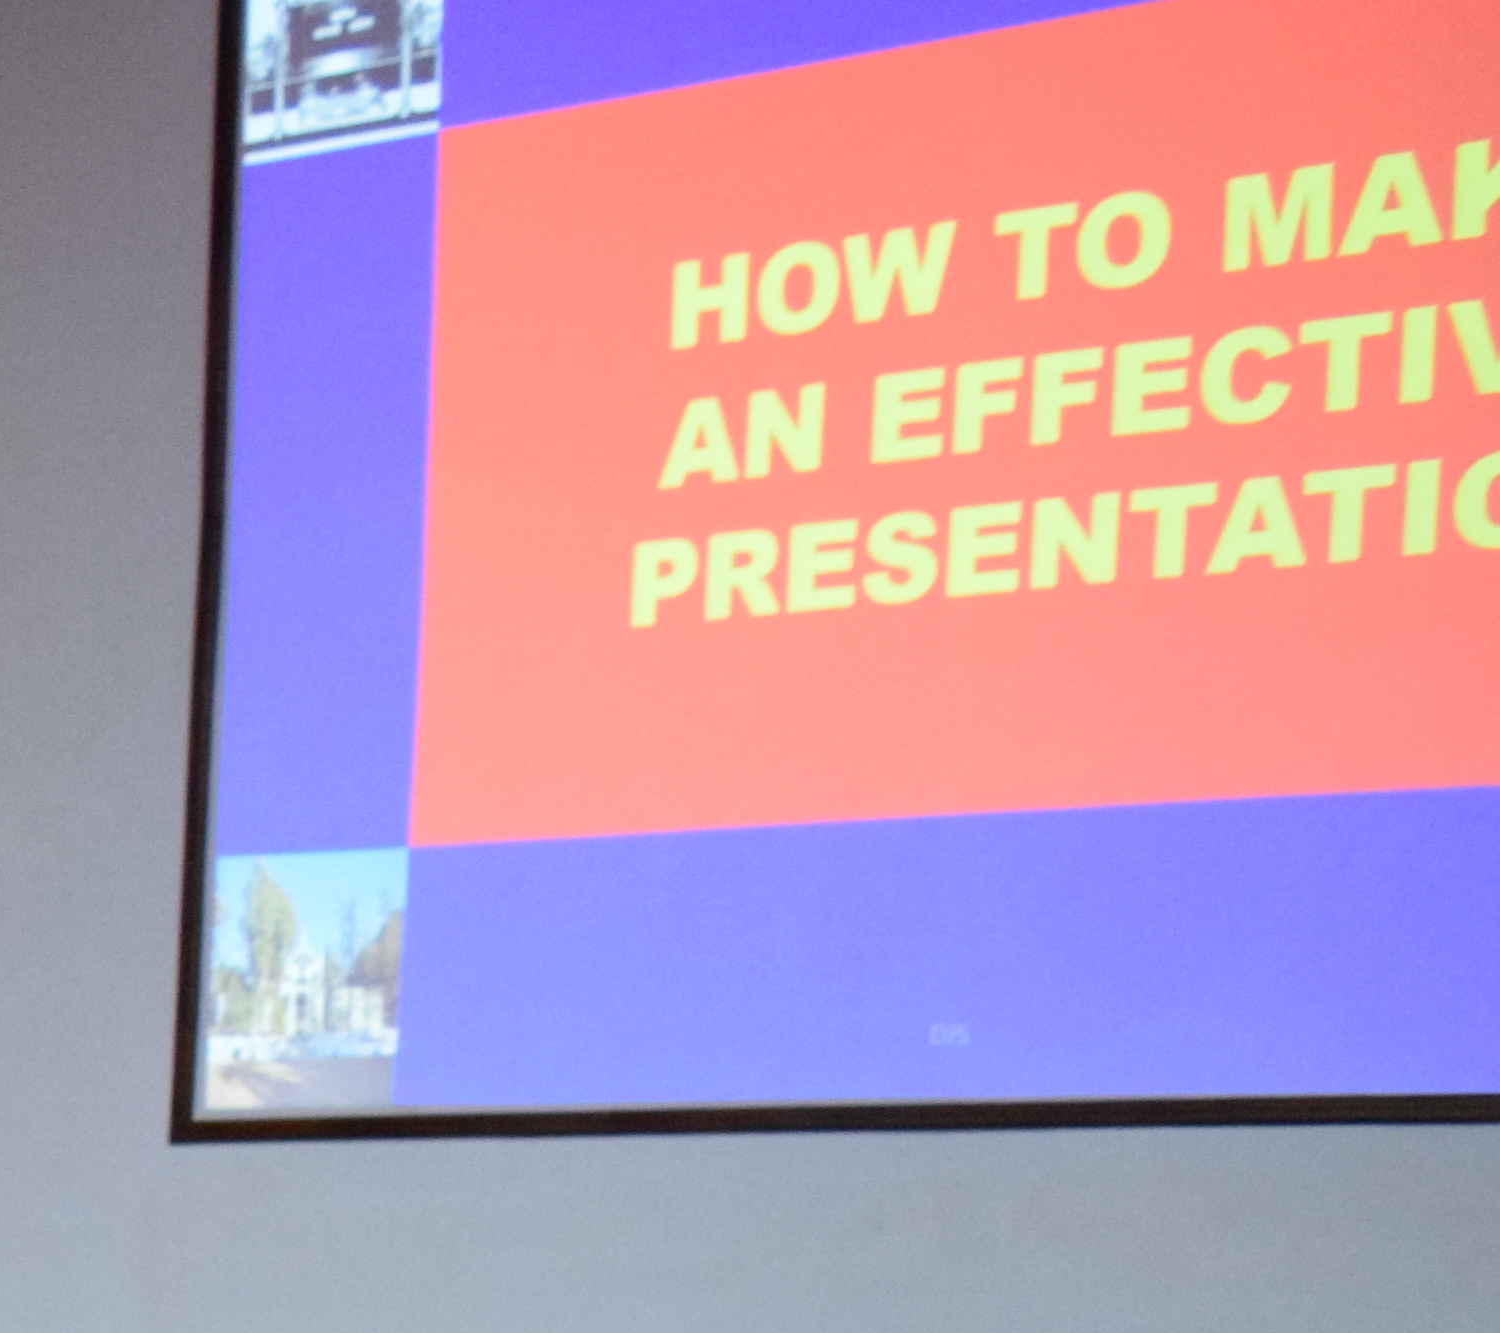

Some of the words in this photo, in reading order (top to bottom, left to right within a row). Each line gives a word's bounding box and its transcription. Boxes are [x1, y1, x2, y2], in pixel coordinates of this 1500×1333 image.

[670, 219, 958, 351] HOW
[994, 190, 1172, 300] TO
[657, 382, 827, 490] AN
